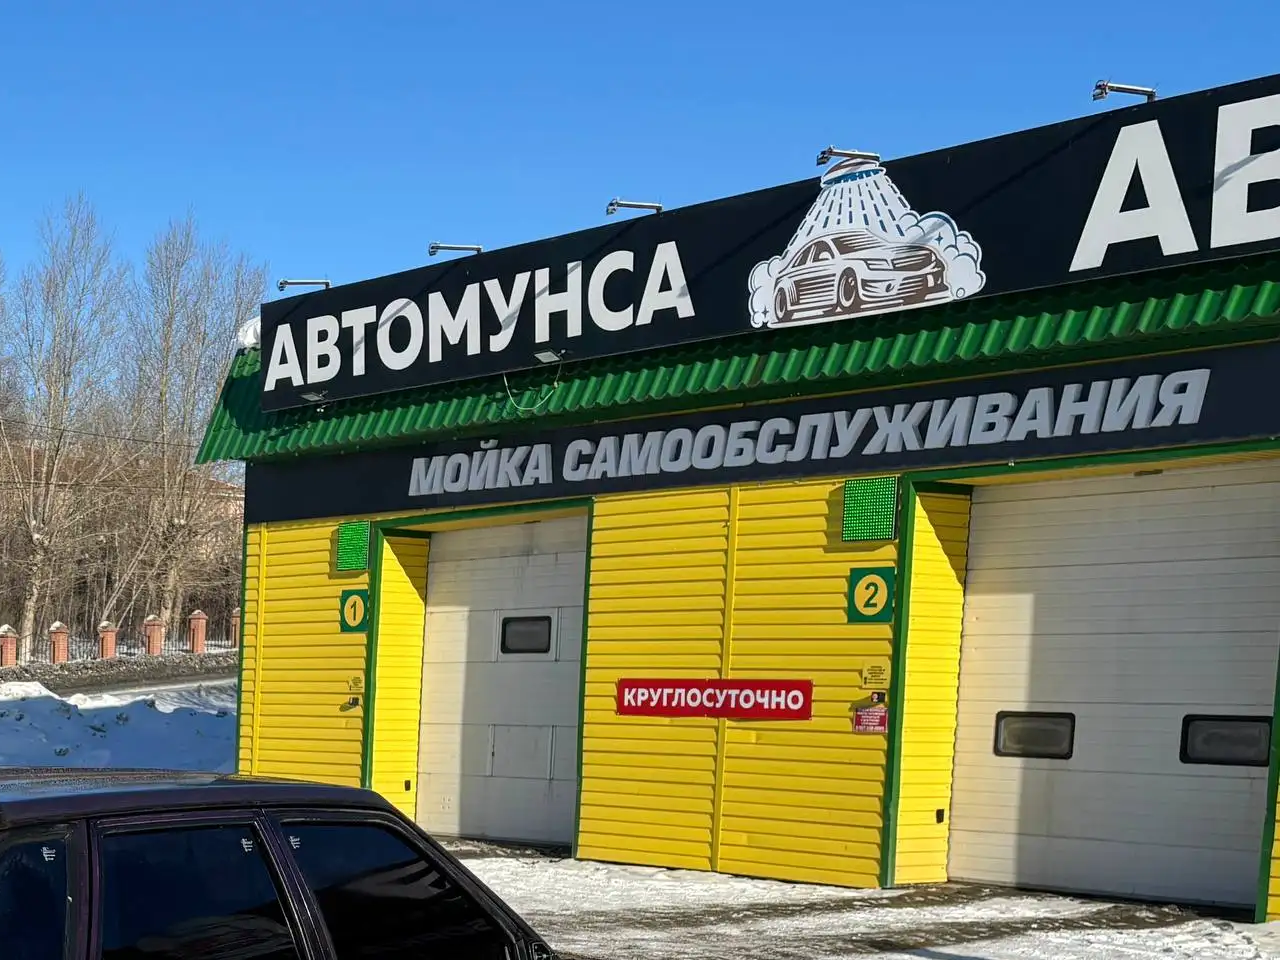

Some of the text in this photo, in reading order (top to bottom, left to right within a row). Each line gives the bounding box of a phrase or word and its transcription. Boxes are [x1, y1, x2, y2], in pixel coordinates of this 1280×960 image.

[263, 240, 696, 392] АВТОМУНСА
[408, 368, 1211, 496] МОЙКА САМООБСЛУЖИВАНИЯ
[863, 581, 879, 608] 2
[350, 600, 357, 621] 1
[623, 687, 805, 710] КРУГЛОСУТОЧНО
